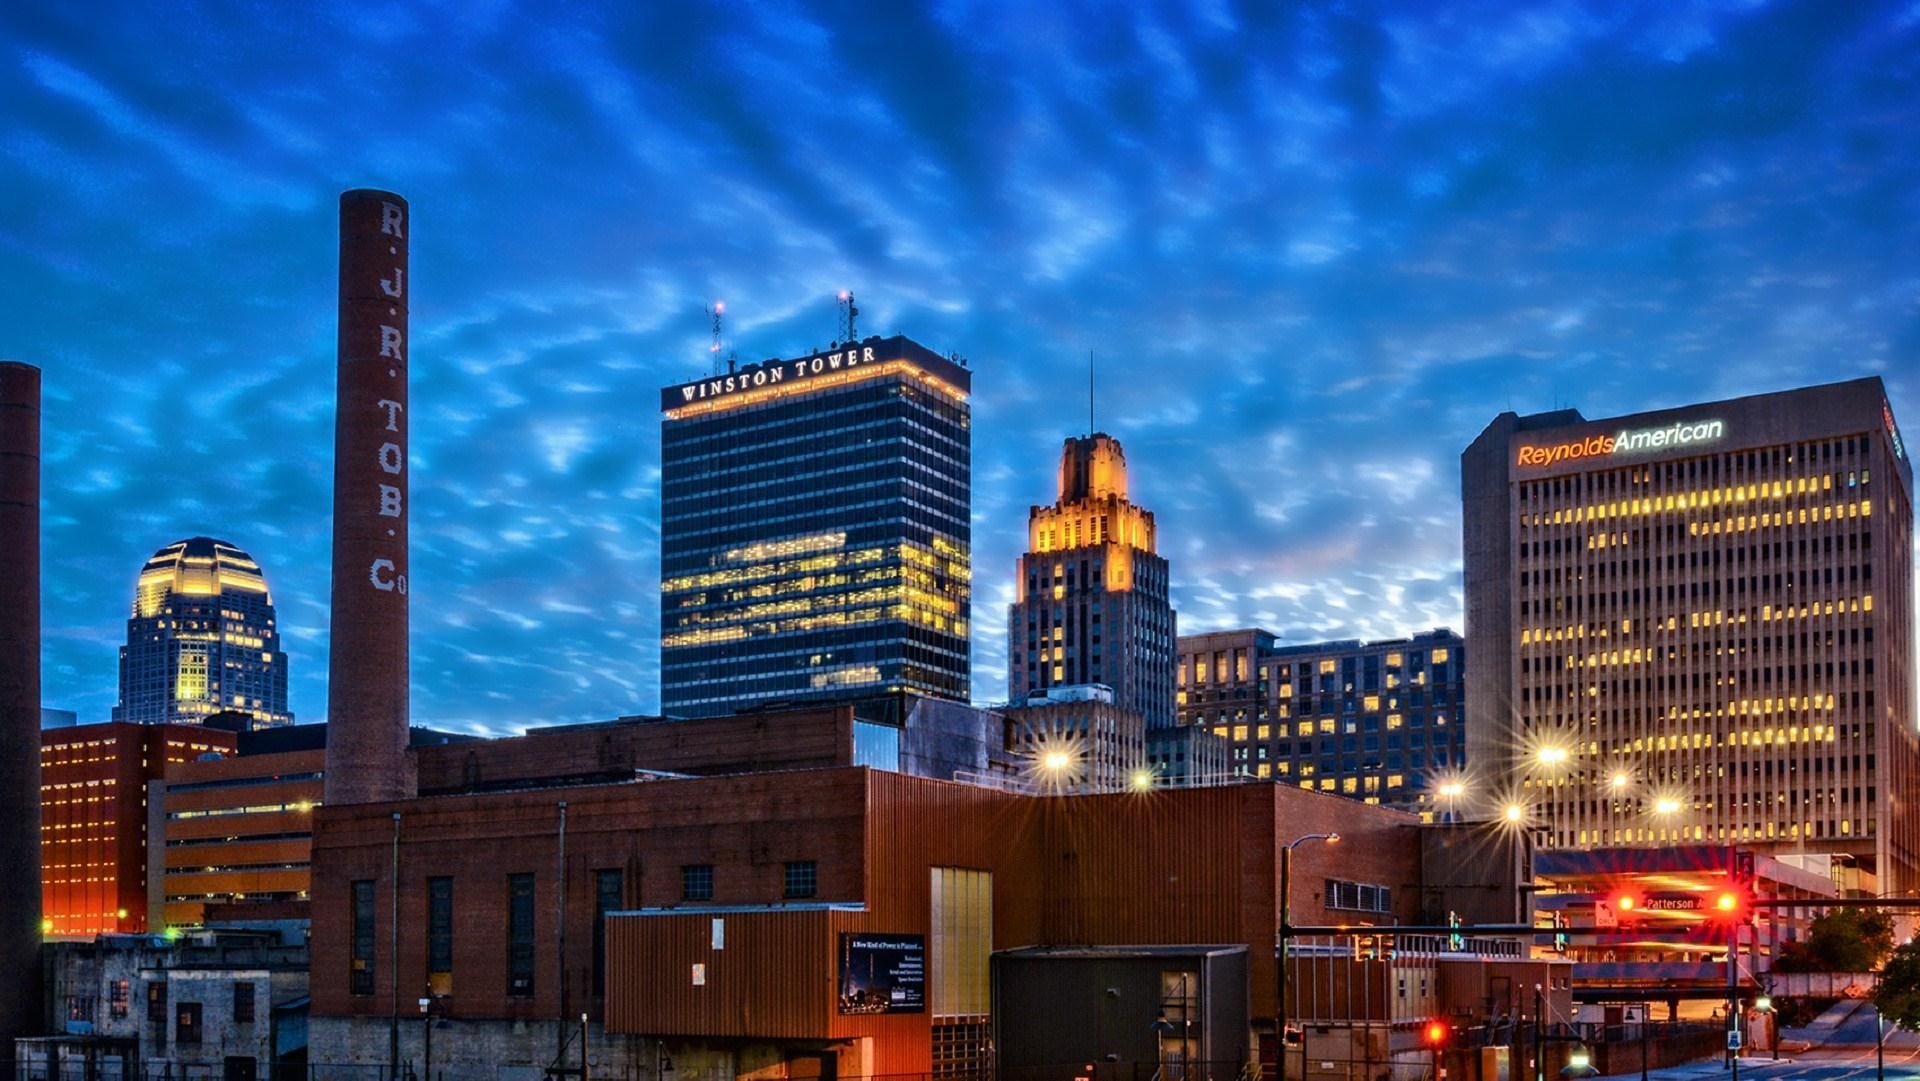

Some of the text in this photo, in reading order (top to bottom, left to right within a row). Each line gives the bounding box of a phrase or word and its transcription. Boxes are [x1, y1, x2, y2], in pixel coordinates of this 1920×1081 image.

[682, 346, 875, 401] WINSTON TOWER
[1647, 898, 1694, 909] Patterson
